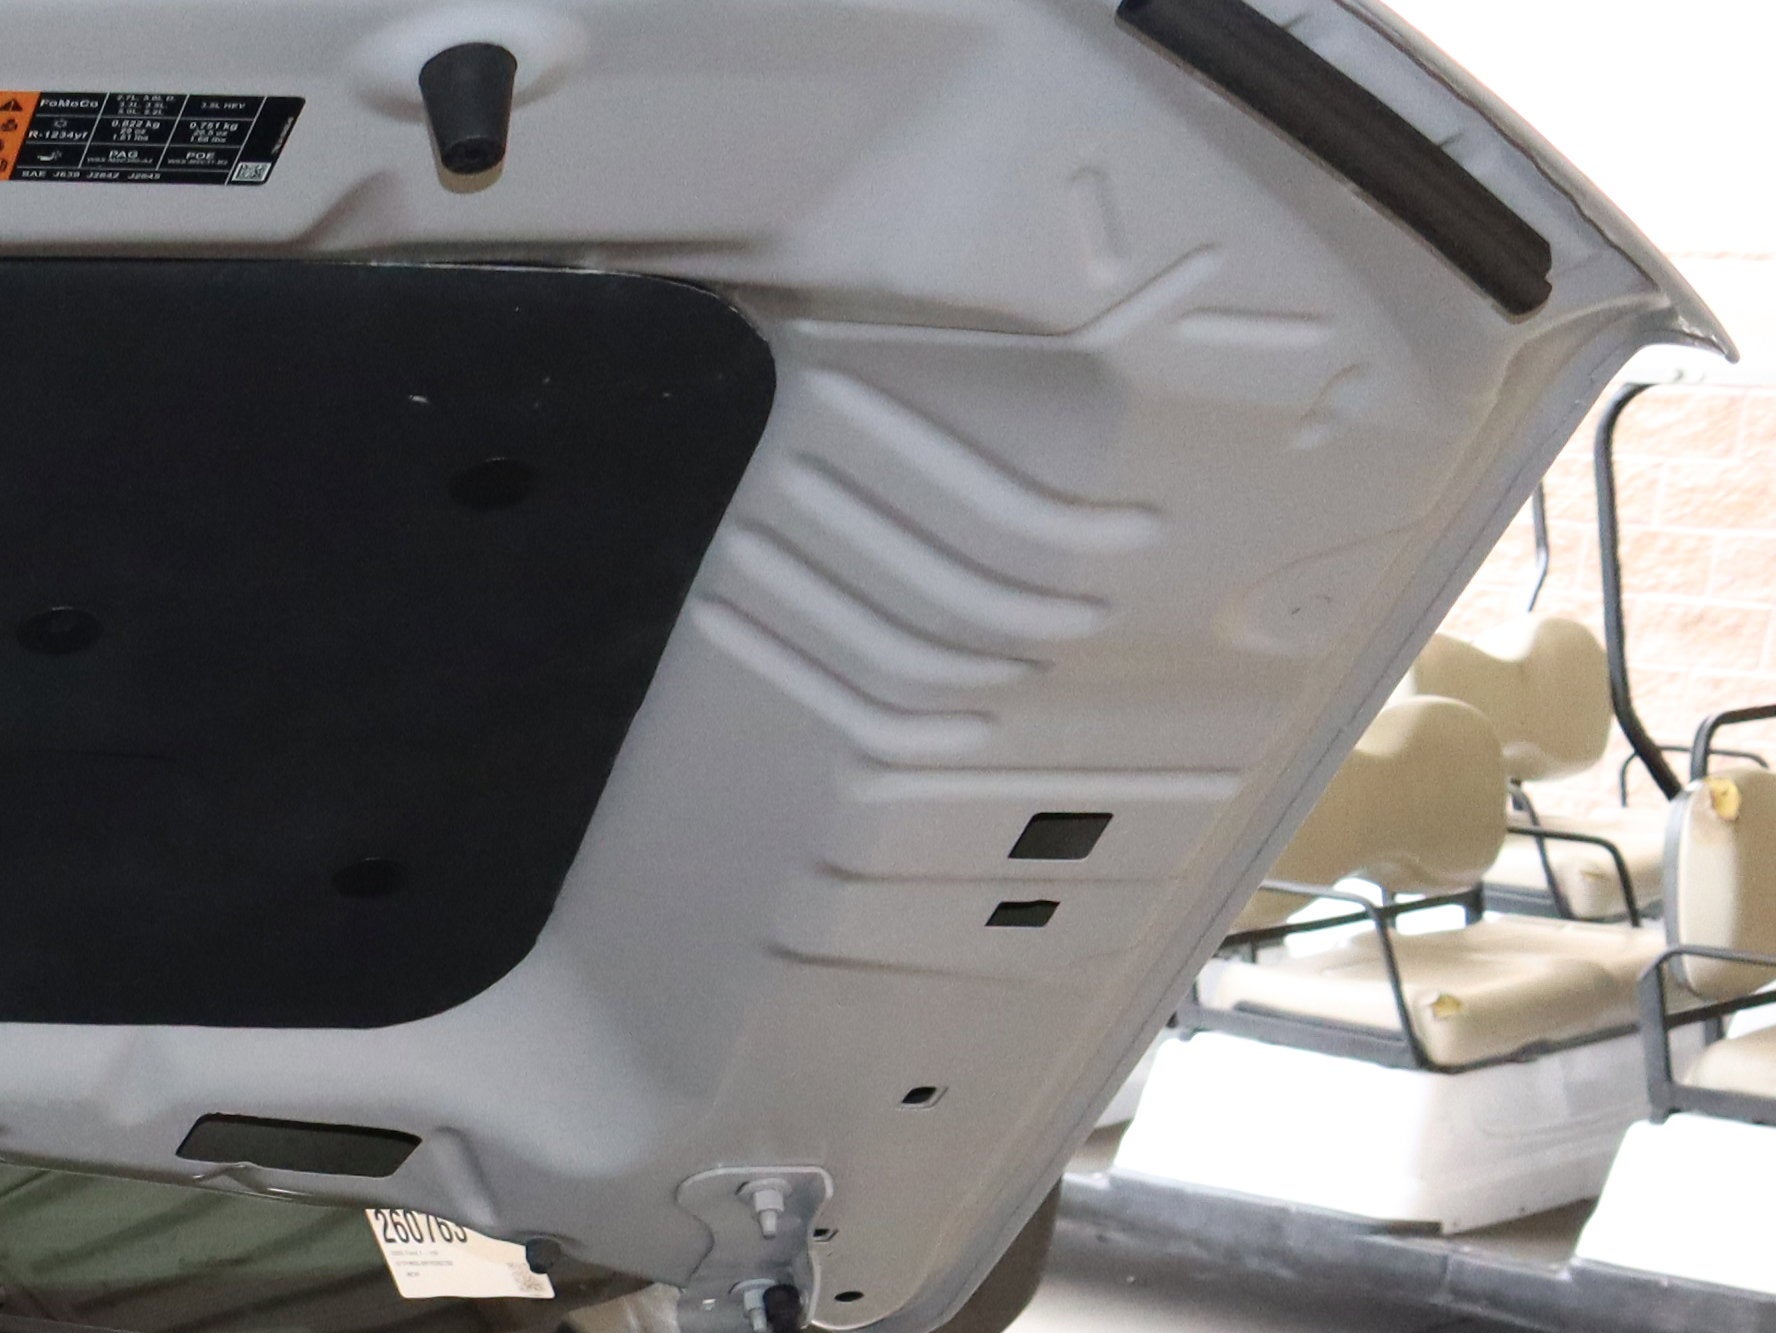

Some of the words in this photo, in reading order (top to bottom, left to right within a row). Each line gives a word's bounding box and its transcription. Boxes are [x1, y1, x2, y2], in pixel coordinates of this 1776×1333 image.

[40, 98, 99, 108] FoMoCo
[145, 120, 161, 129] kg
[223, 121, 238, 132] kg
[28, 130, 89, 140] R-1234yf
[109, 149, 139, 159] PAG
[186, 151, 216, 160] POE
